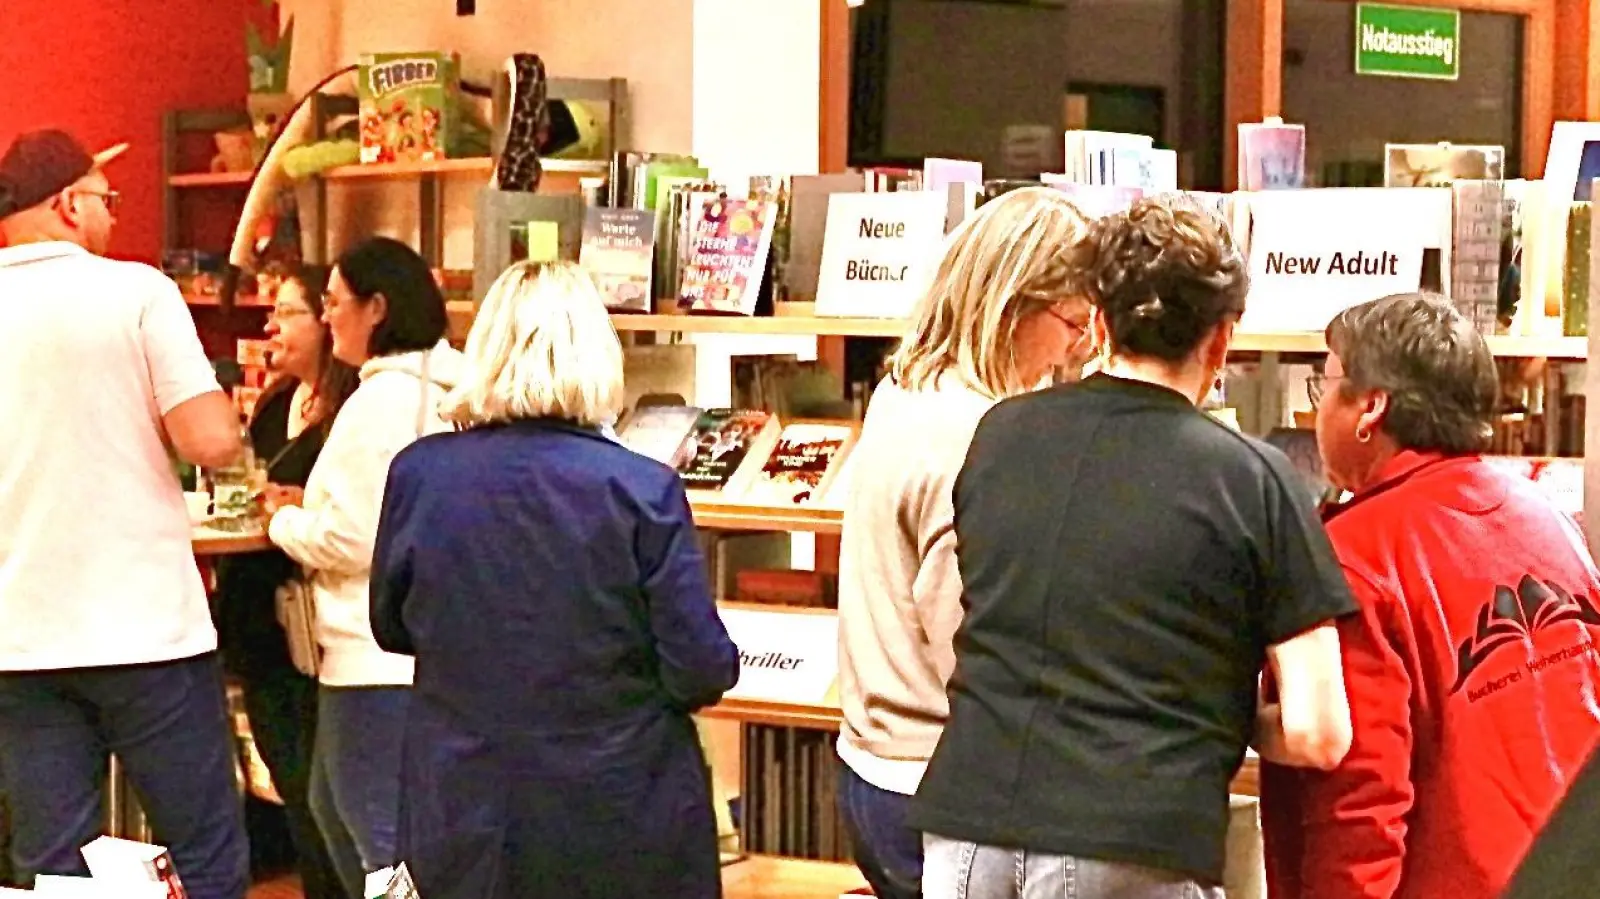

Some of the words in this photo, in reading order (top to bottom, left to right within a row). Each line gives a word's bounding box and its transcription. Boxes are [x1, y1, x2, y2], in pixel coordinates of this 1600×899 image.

[1362, 23, 1453, 65] Notausstieg
[371, 61, 436, 96] FIBBER
[697, 220, 720, 233] DIE
[858, 217, 905, 239] Neue
[1265, 251, 1321, 275] New
[1327, 250, 1399, 276] Adult
[739, 650, 804, 670] hriller
